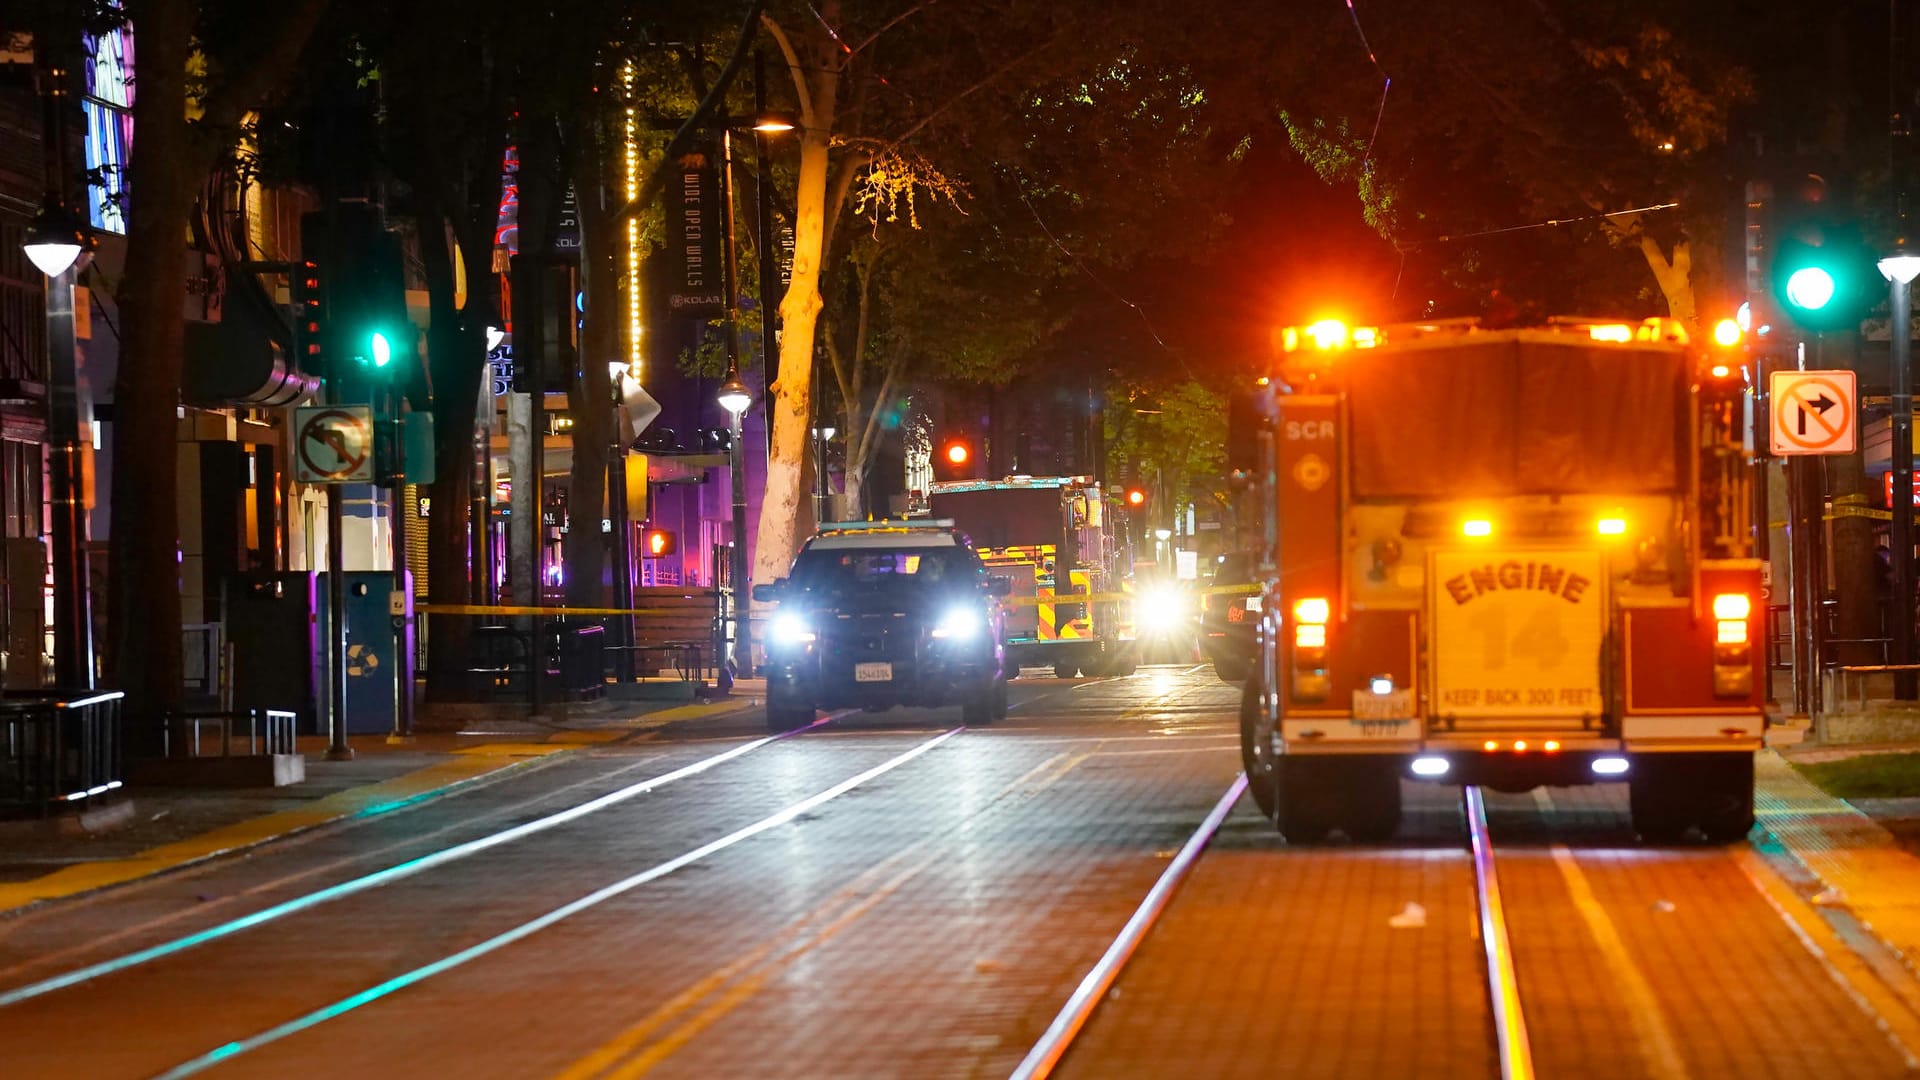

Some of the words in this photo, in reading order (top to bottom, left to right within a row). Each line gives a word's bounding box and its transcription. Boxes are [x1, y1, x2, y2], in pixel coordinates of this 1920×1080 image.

[683, 173, 701, 204] WIDE
[684, 209, 702, 241] OPEN
[686, 245, 703, 287] WALLS
[1286, 420, 1335, 440] SCR
[1445, 561, 1591, 606] ENGINE
[1469, 602, 1570, 673] 14
[1444, 688, 1481, 706] KEEP
[1484, 688, 1521, 706] BACK
[1559, 686, 1594, 704] FEET
